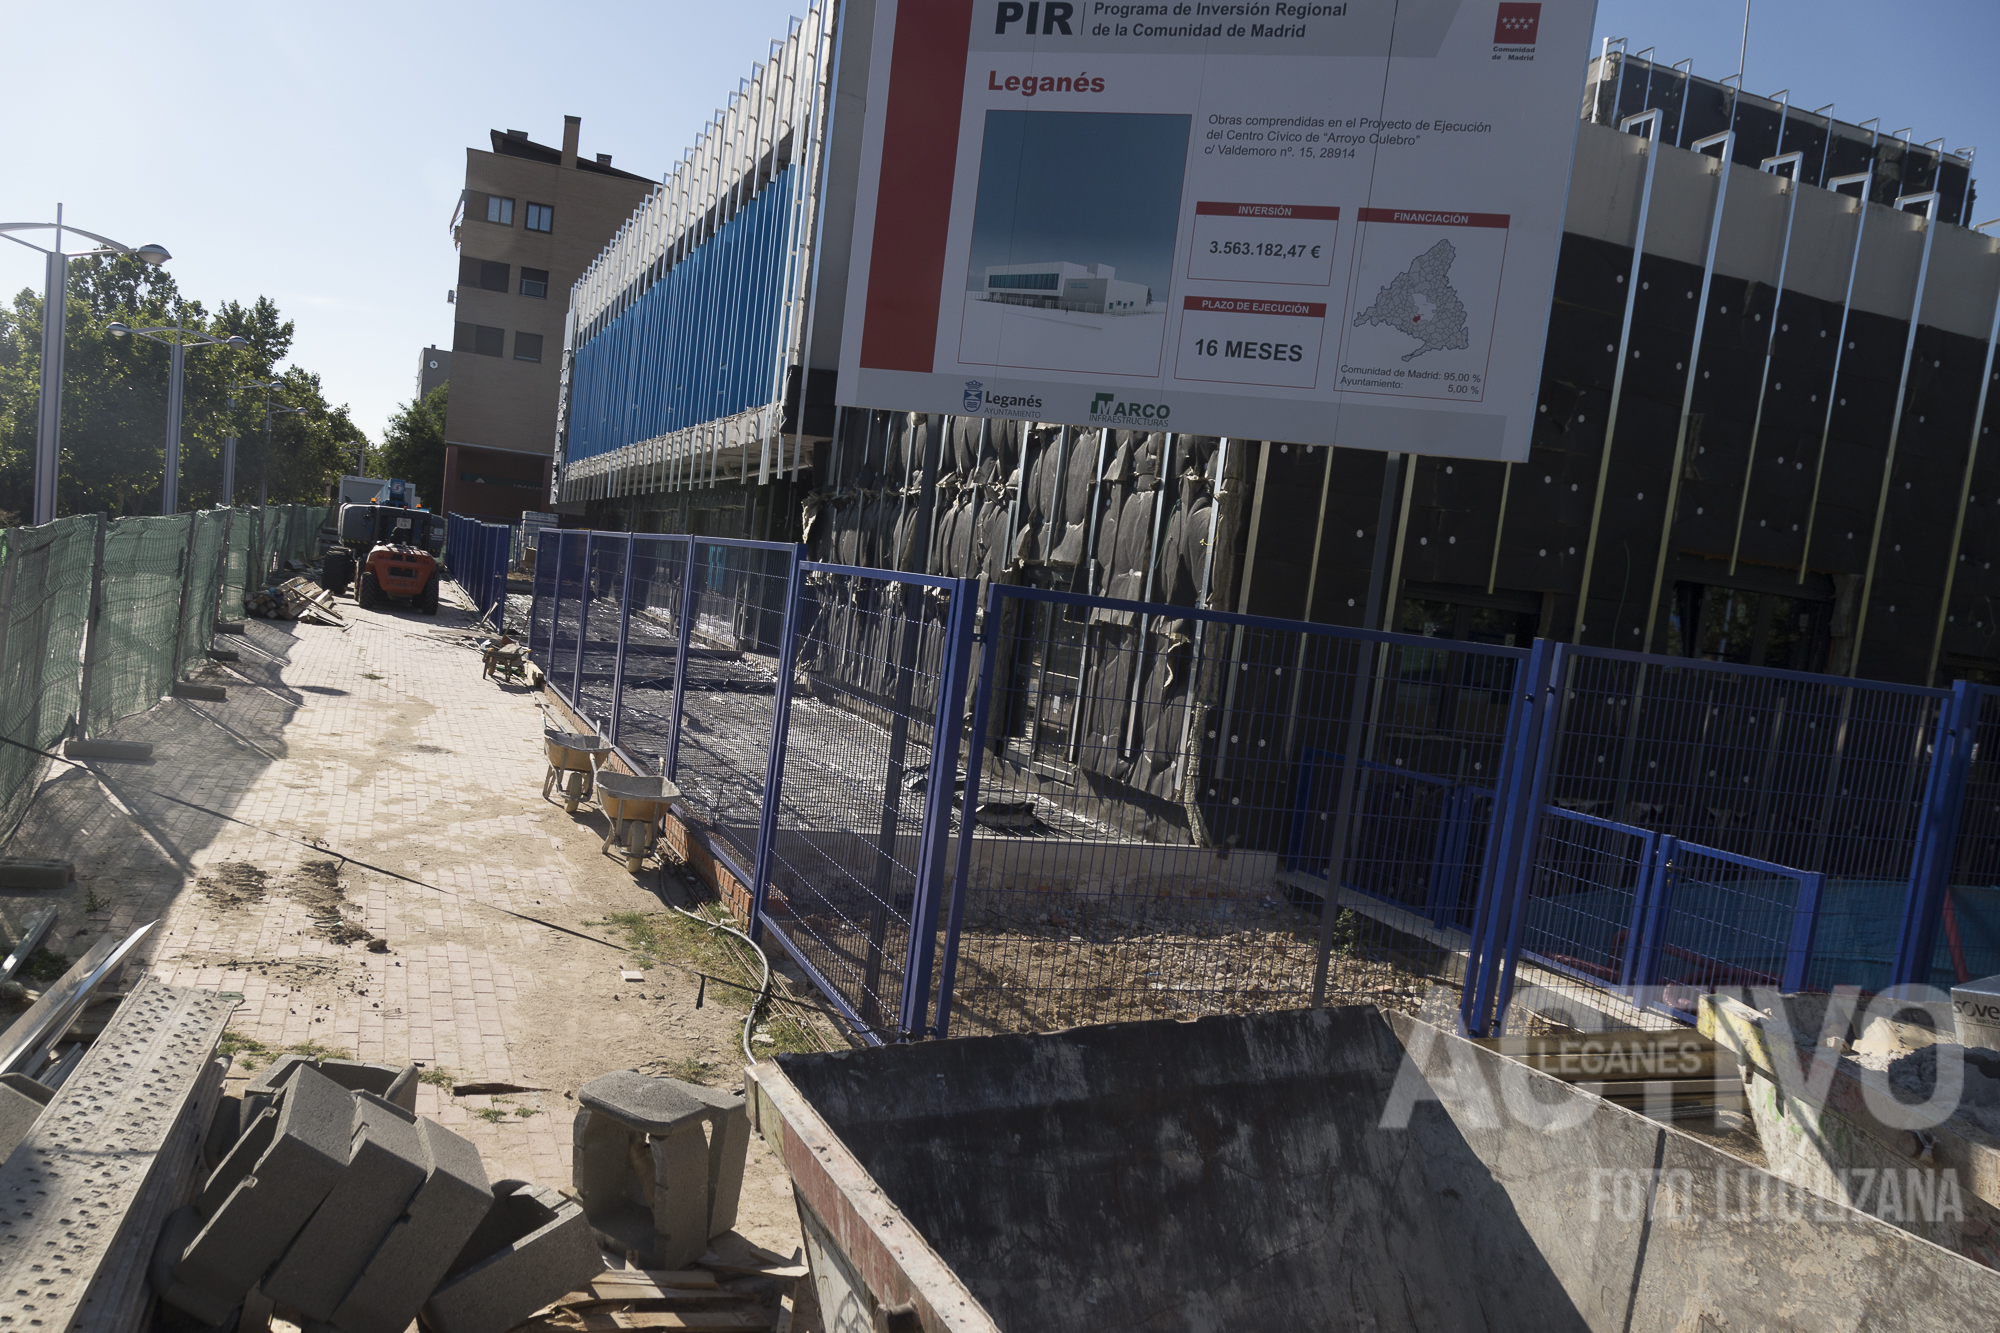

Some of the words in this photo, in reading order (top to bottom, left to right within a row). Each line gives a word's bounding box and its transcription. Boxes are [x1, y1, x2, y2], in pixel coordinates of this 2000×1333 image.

[994, 1, 1074, 35] PIR
[1094, 3, 1169, 19] Programa
[1173, 3, 1192, 16] de
[1196, 2, 1270, 17] Inversión
[1275, 2, 1347, 19] Regional
[1092, 23, 1110, 37] de
[1115, 23, 1128, 37] la
[1132, 23, 1221, 37] Comunidad
[1227, 24, 1246, 38] de
[1250, 24, 1306, 38] Madrid
[988, 70, 1106, 97] Leganés
[1208, 114, 1242, 126] Obras
[1245, 115, 1324, 130] comprendidas
[1328, 118, 1342, 128] en
[1346, 117, 1357, 128] el
[1360, 118, 1412, 131] Proyecto
[1415, 120, 1430, 131] de
[1433, 120, 1492, 133] Ejecución
[1206, 129, 1223, 140] del
[1226, 129, 1263, 141] Centro
[1267, 130, 1302, 142] Cívico
[1305, 131, 1319, 143] de
[1204, 144, 1216, 155] c/
[1218, 144, 1277, 157] Valdemoro
[1299, 147, 1316, 159] 15,
[1319, 147, 1355, 159] 28914
[1238, 205, 1292, 216] INVERSIÓN
[1393, 212, 1469, 224] FINANCIACIÓN
[1209, 240, 1307, 259] 3.563.182,47
[1310, 245, 1321, 259] €
[1201, 300, 1234, 310] PLAZO
[1236, 302, 1250, 311] DE
[1252, 302, 1309, 314] EJECUCIÓN
[1195, 338, 1219, 357] 16
[1224, 340, 1303, 362] MESES
[1340, 364, 1392, 377] Comunidad
[1393, 368, 1406, 378] de
[1407, 369, 1441, 380] Madrid:
[1443, 372, 1470, 383] 95,00
[1472, 373, 1482, 384] %
[1339, 376, 1404, 389] Ayuntamiento:
[1447, 384, 1468, 395] 5,00
[1470, 385, 1480, 395] %
[984, 391, 1043, 408] Leganés
[1090, 394, 1171, 420] MARCO
[983, 407, 1042, 419] AYUNTAMIENTO
[1089, 413, 1169, 428] INFRAESTRUCTURAS
